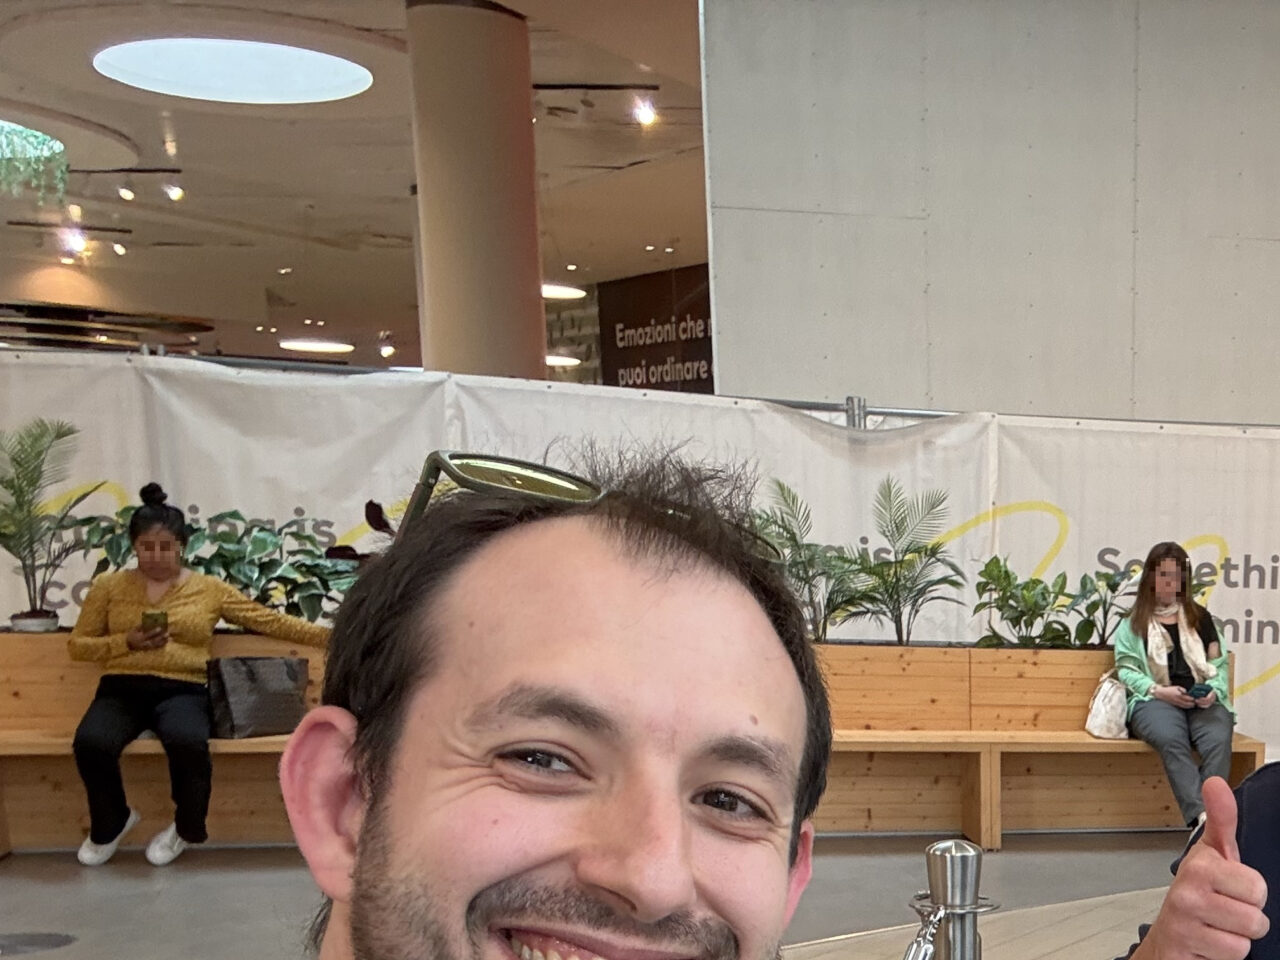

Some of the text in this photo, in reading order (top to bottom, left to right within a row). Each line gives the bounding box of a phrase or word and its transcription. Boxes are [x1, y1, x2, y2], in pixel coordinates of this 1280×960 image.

[615, 315, 676, 348] Emozioni
[679, 313, 705, 340] che
[617, 355, 708, 387] puoi ordinare
